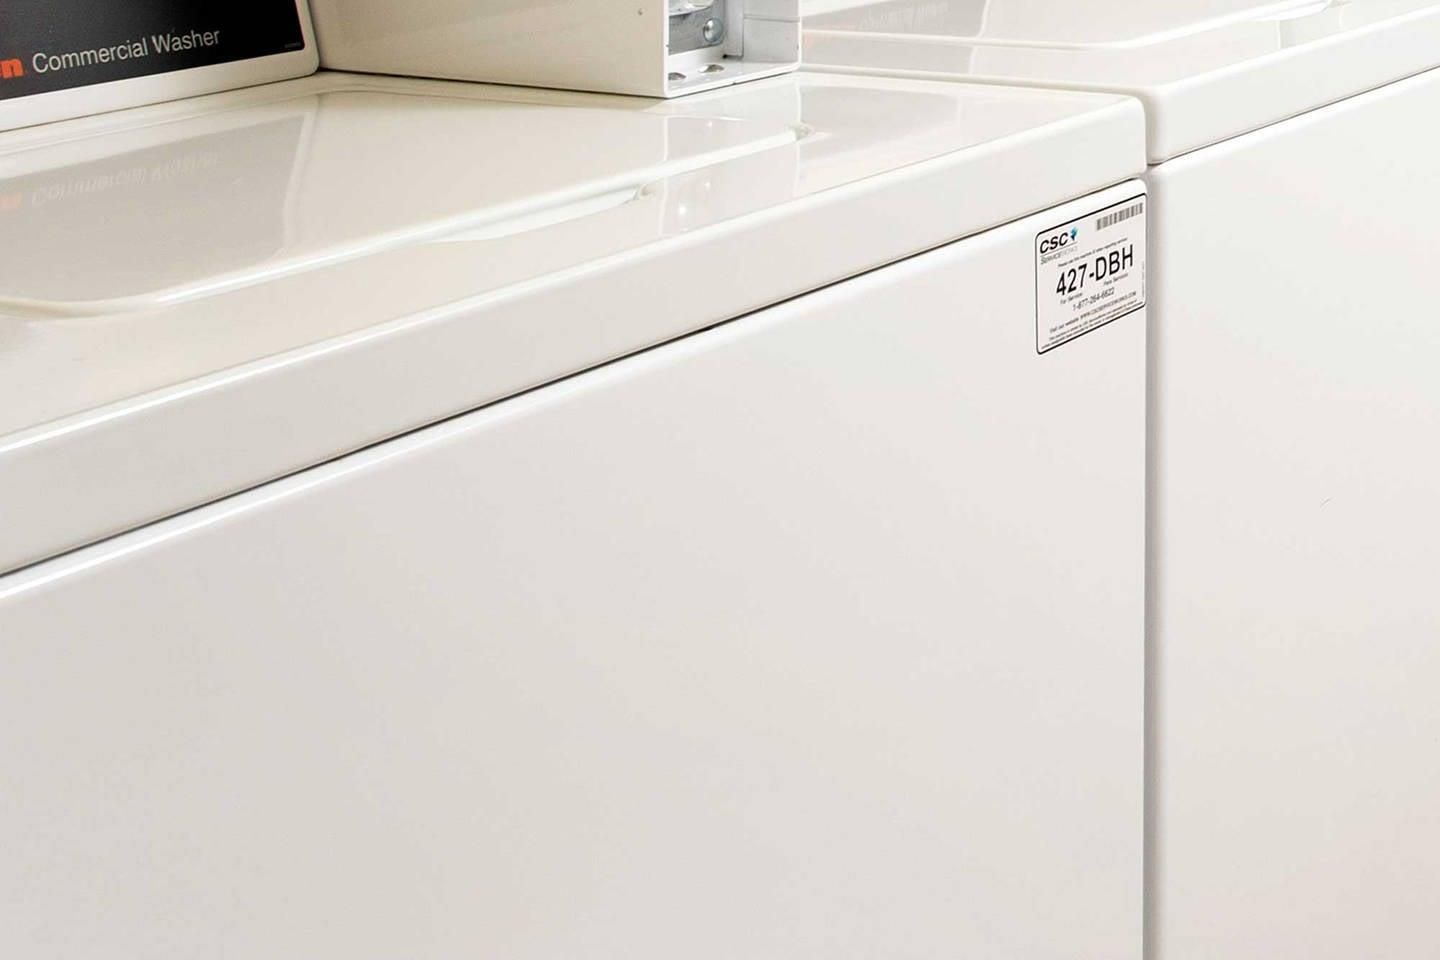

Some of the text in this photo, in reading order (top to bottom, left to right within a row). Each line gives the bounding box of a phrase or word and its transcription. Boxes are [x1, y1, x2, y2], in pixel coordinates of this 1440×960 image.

[32, 37, 149, 73] Commercial
[151, 29, 220, 55] Washer
[1039, 232, 1069, 254] CSC
[1056, 244, 1134, 296] 427-DBH
